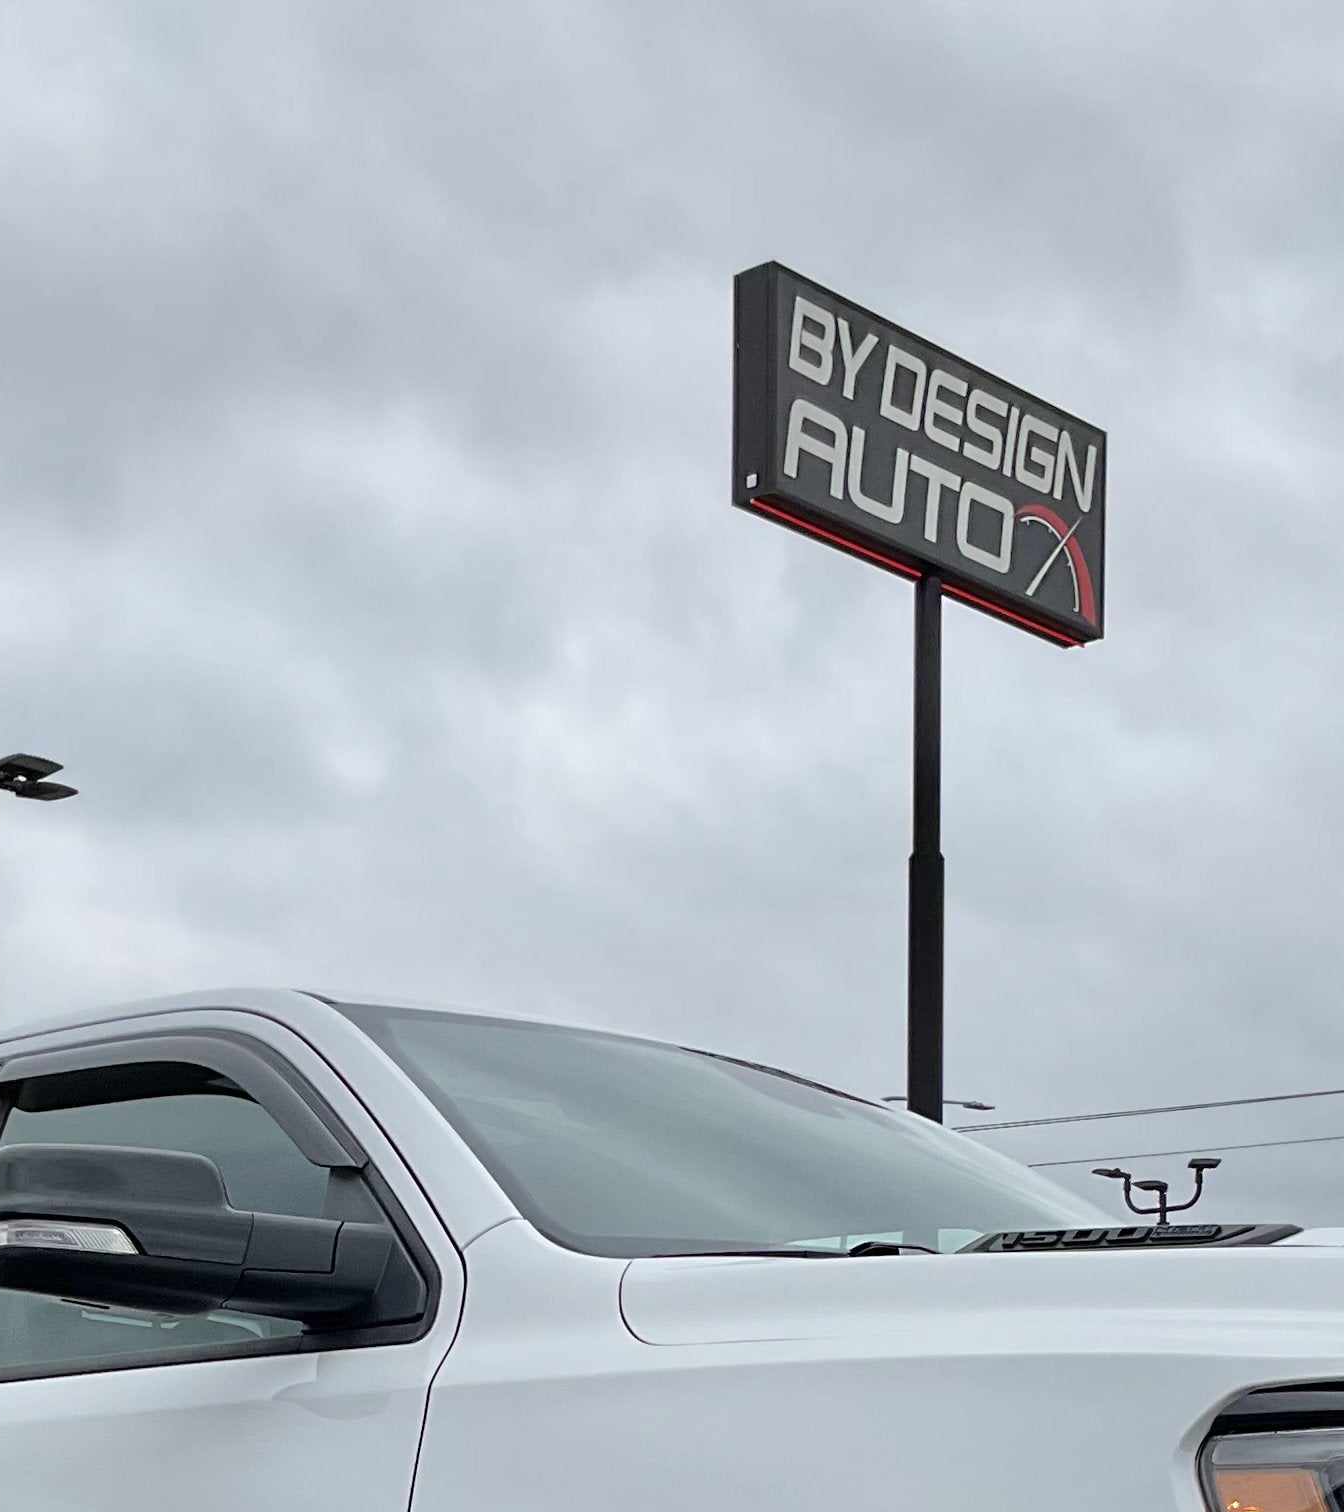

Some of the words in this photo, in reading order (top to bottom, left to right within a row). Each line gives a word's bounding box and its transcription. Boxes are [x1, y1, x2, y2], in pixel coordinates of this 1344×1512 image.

[784, 399, 1015, 574] AUTO
[789, 295, 879, 400] BY
[880, 344, 1097, 513] DESIGN
